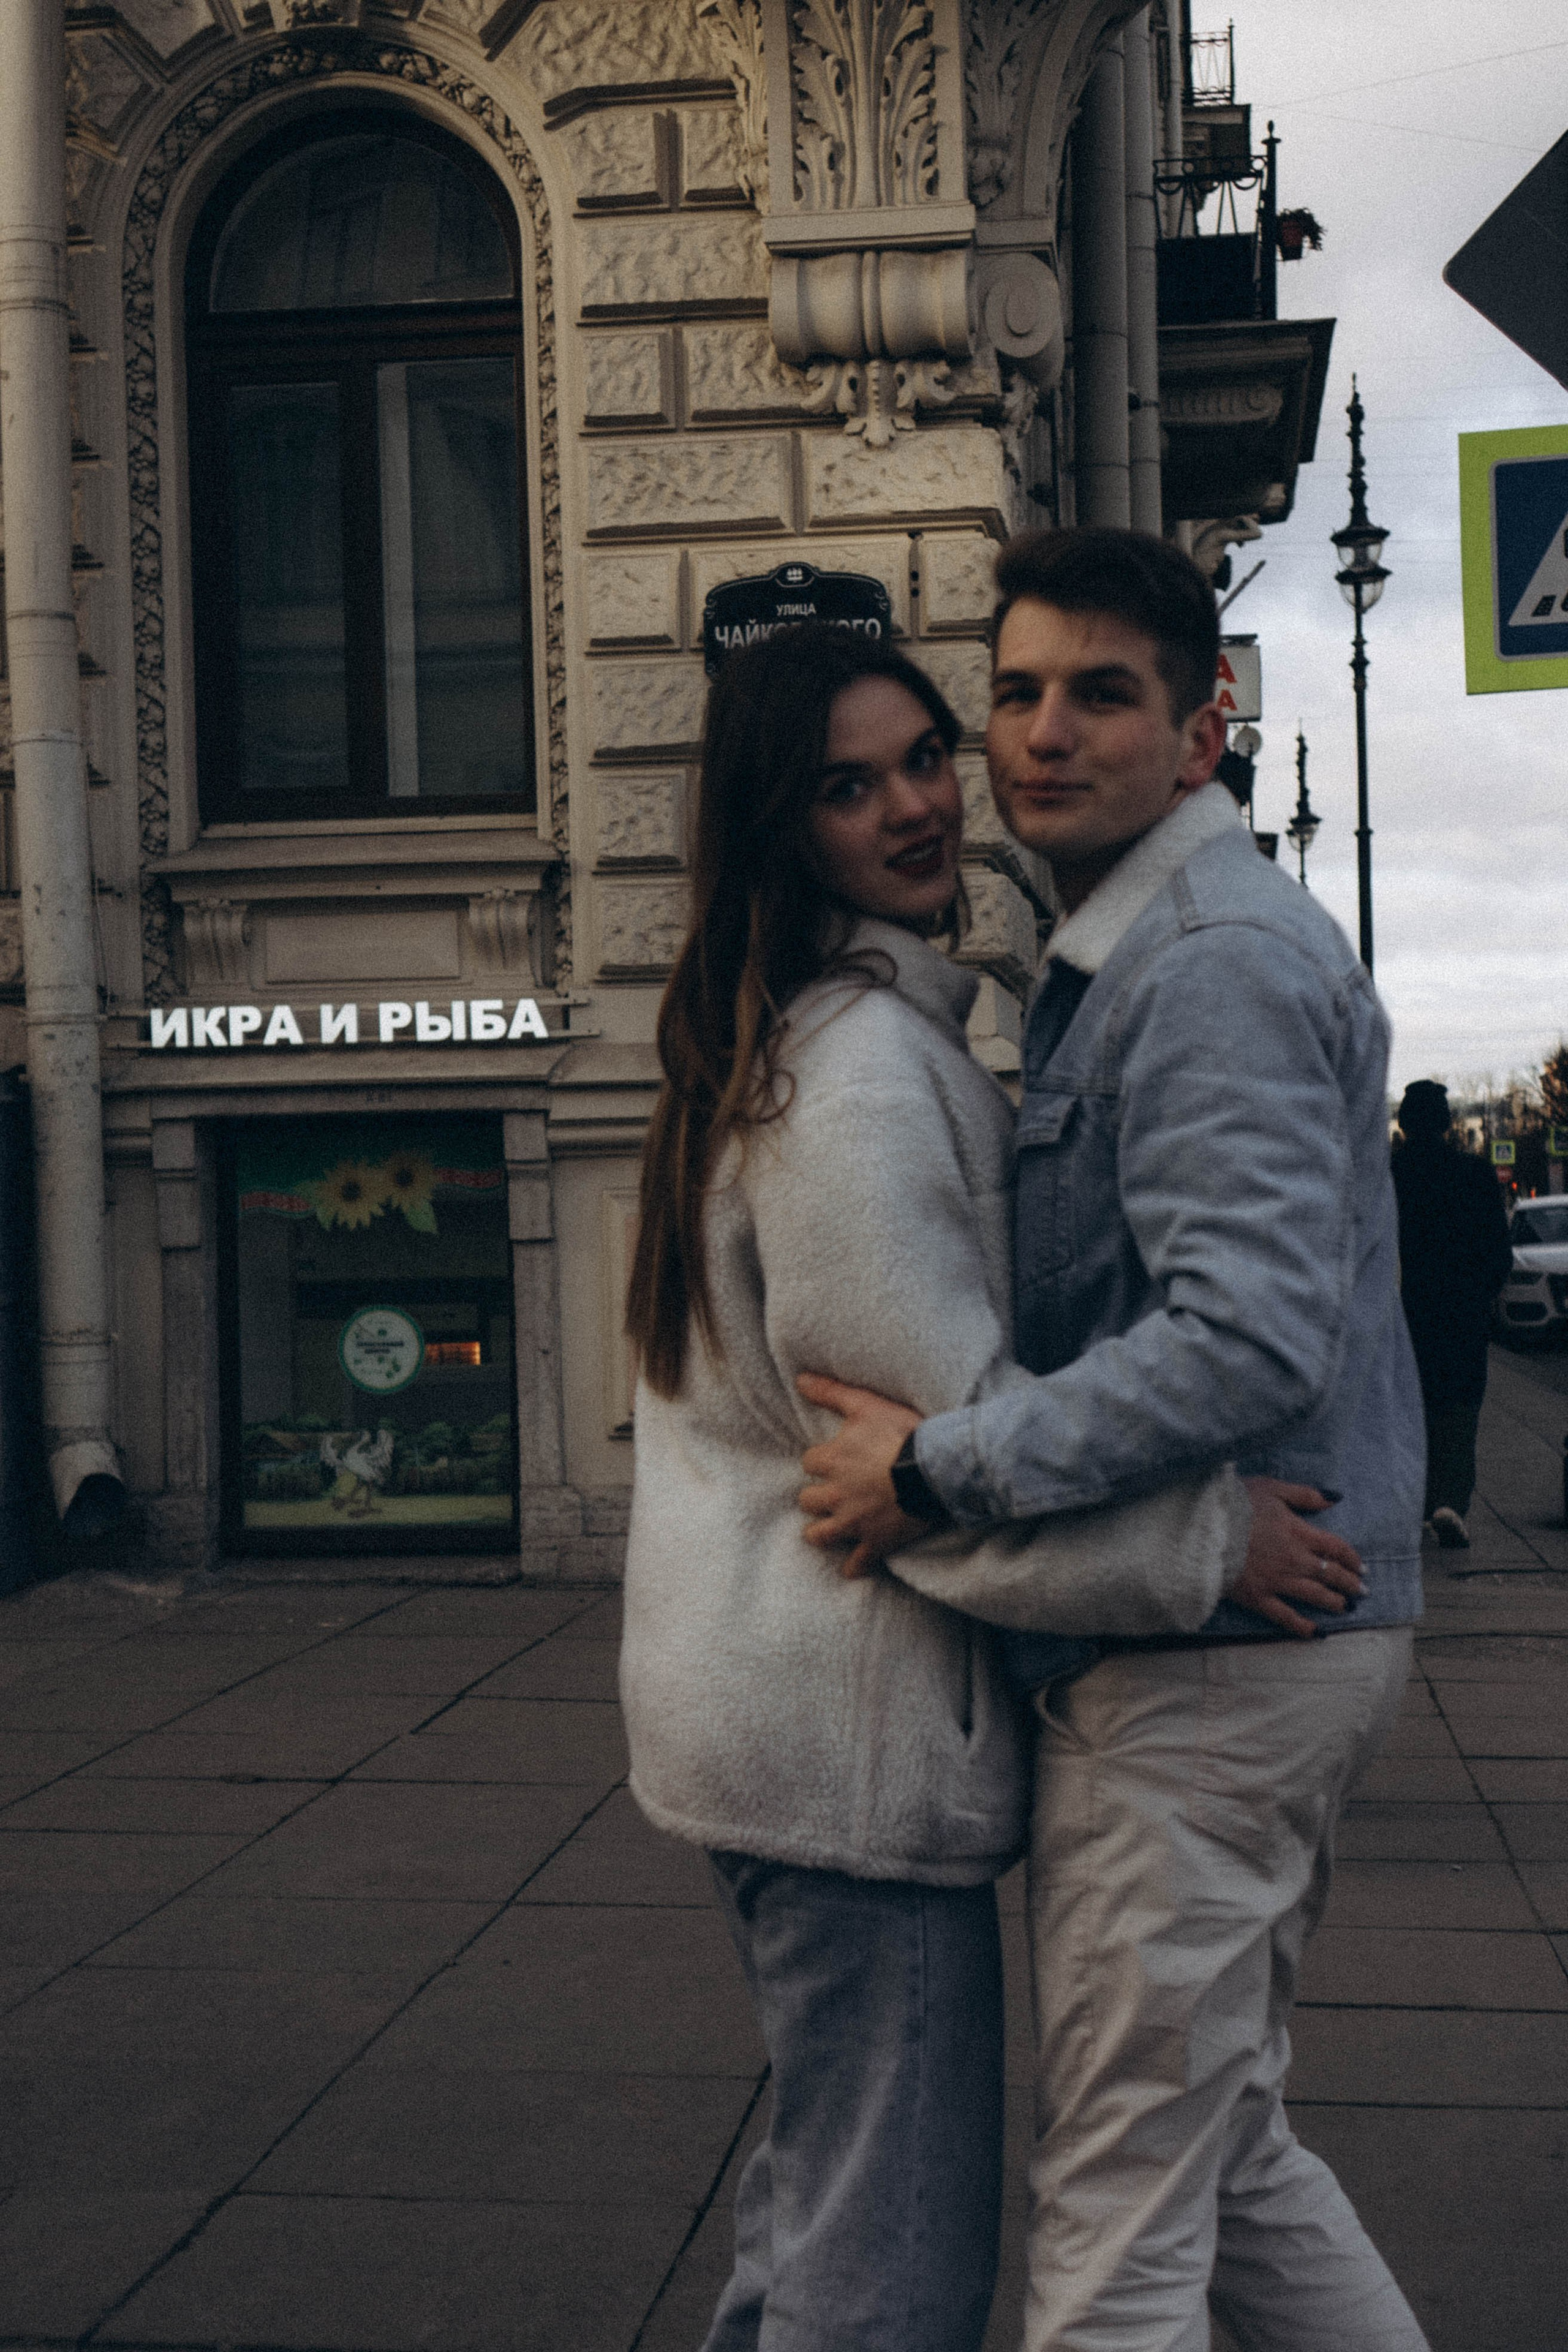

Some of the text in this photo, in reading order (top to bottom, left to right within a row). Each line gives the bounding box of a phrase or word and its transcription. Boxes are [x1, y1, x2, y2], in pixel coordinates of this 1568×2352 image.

[776, 603, 816, 616] УЛИЦА
[150, 998, 549, 1047] ИКРА И РЫБА
